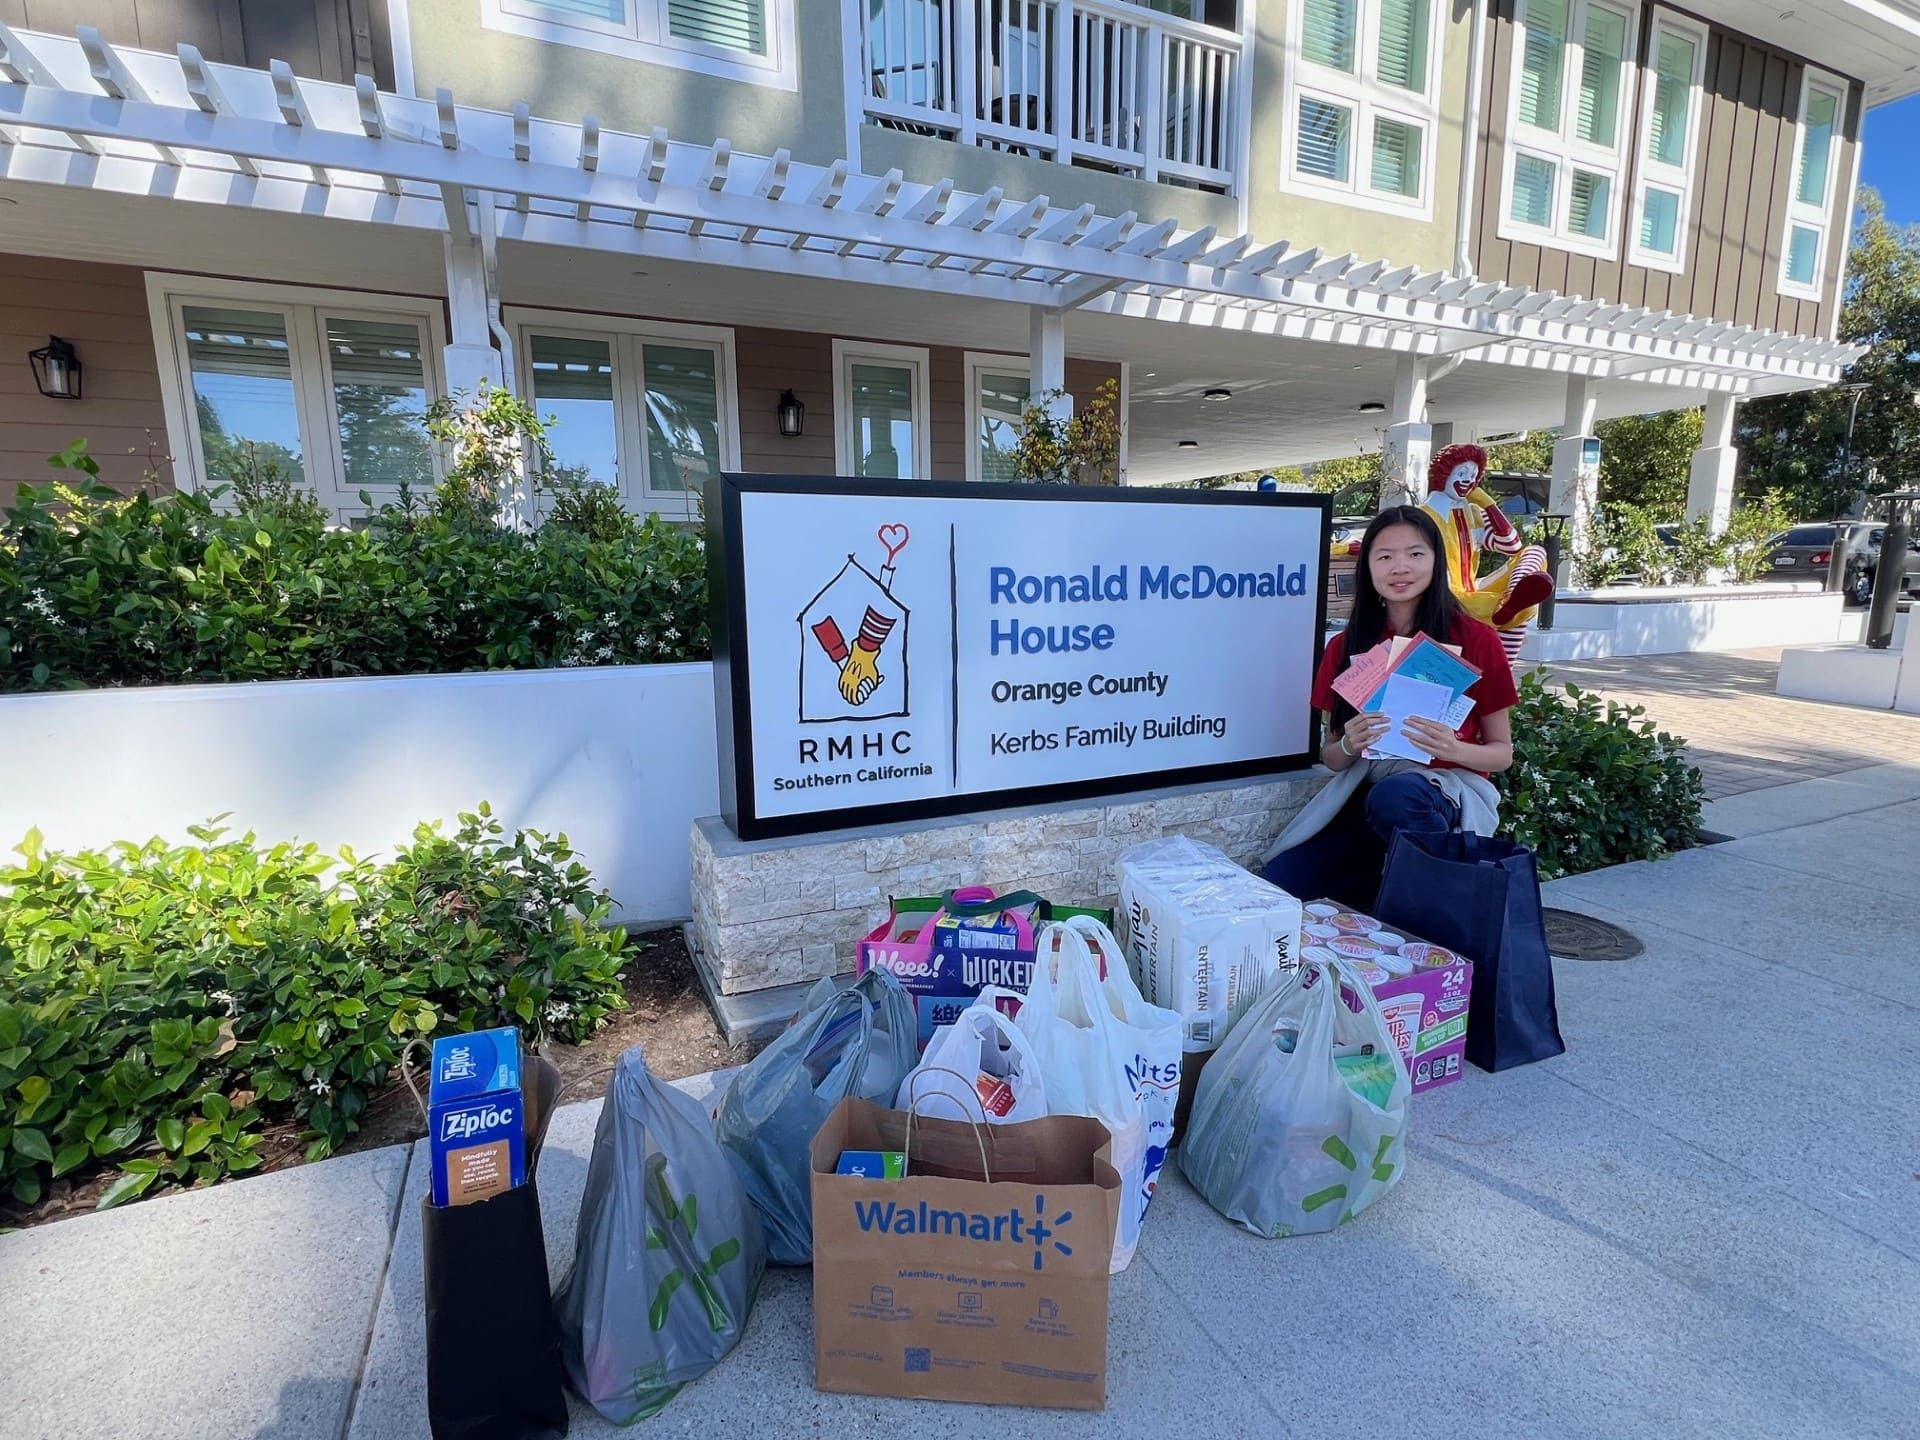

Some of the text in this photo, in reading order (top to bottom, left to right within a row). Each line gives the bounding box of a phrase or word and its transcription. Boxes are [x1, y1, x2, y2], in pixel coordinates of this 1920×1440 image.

[989, 563, 1307, 605] Ronald McDonald
[989, 618, 1116, 656] House
[991, 671, 1169, 705] Orange County
[990, 714, 1227, 756] Kerbs Family Building
[773, 762, 934, 791] Southern California
[1198, 945, 1208, 1011] ENTERTAIN
[1442, 969, 1464, 988] 24
[444, 1046, 476, 1080] Ziploc
[446, 1107, 513, 1138] Ziploc
[898, 1269, 944, 1281] Members
[948, 1274, 978, 1287] always
[981, 1278, 997, 1288] get
